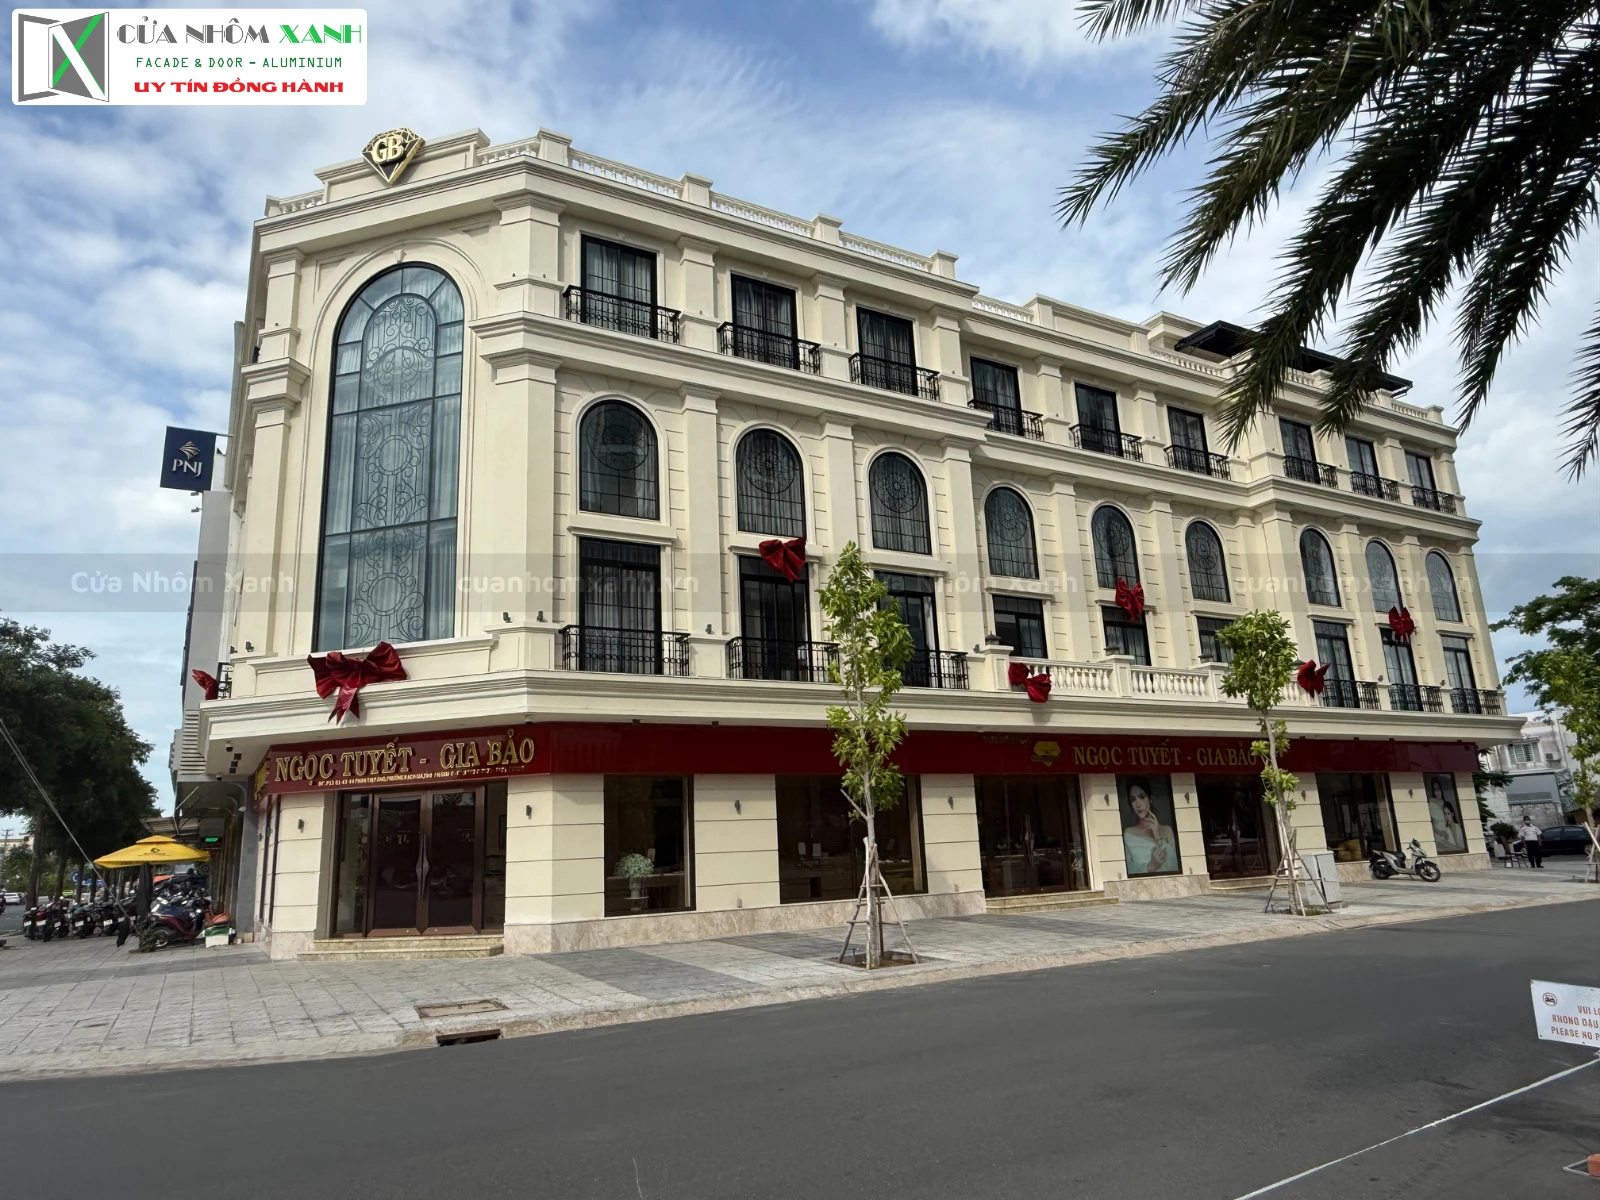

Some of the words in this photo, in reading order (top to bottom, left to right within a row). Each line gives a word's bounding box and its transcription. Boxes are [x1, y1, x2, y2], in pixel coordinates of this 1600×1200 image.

[372, 134, 404, 164] GB
[172, 458, 203, 477] PNJ
[275, 753, 334, 785] NGỌC
[341, 737, 413, 777] TUYẾT
[440, 741, 480, 769] GIA
[487, 729, 535, 764] BẢO
[1073, 746, 1122, 769] NGỌC
[1128, 738, 1181, 766] TUYẾT
[1197, 748, 1225, 766] GIA
[1227, 740, 1258, 766] BẢO
[1577, 1005, 1592, 1015] VUI
[1551, 1026, 1579, 1038] PLEASE
[1582, 1031, 1593, 1040] NO
